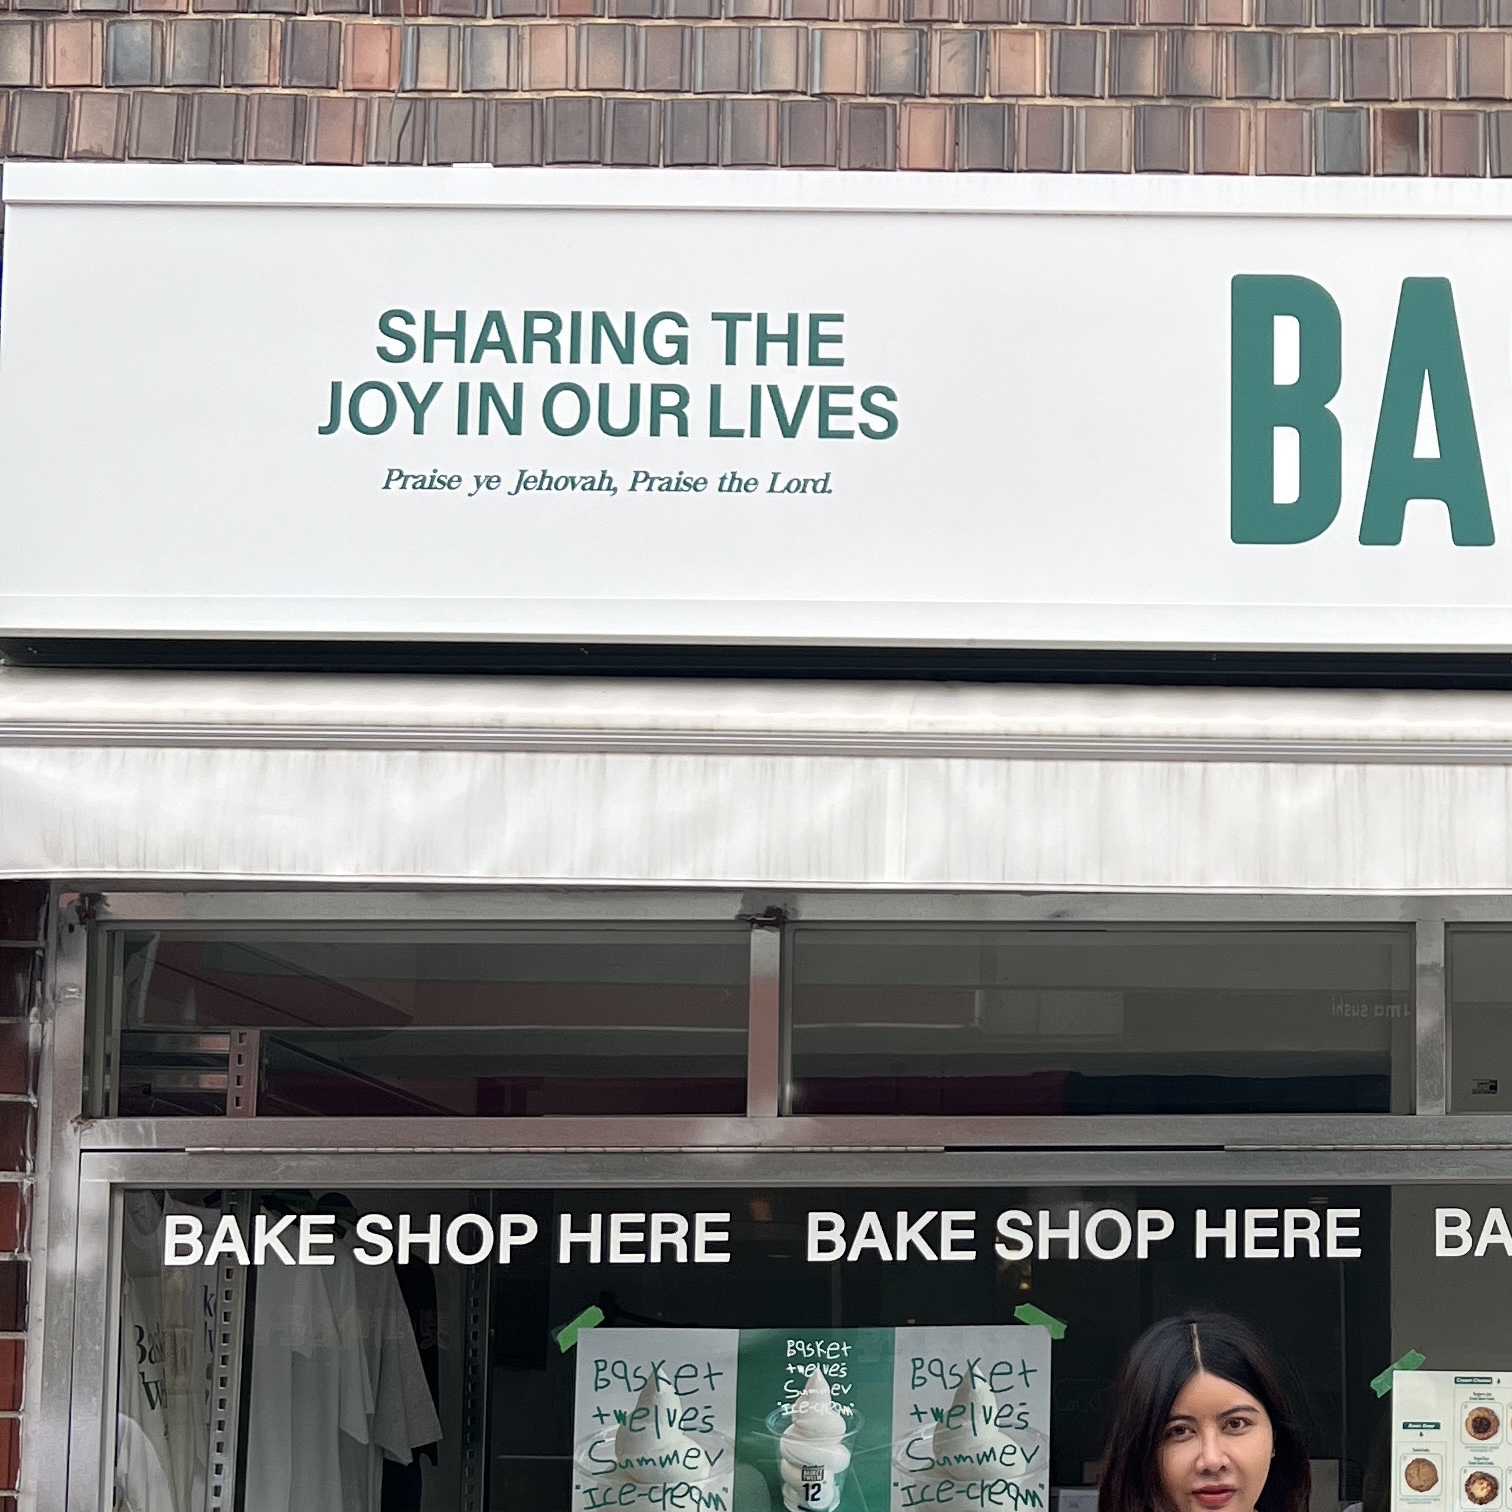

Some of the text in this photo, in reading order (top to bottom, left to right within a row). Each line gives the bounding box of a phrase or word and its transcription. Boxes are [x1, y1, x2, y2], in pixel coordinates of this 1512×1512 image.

[376, 309, 845, 366] SHARING THE
[318, 381, 899, 440] JOY IN OUR LIVES
[382, 469, 834, 497] Praise ye Jehovah, Praise the Lord.
[164, 1215, 335, 1265] BAKE
[354, 1214, 537, 1265] SHOP
[560, 1213, 730, 1263] HERE
[807, 1211, 976, 1261] BAKE
[995, 1210, 1174, 1260] SHOP
[1196, 1209, 1361, 1258] HERE
[786, 1339, 852, 1360] Basket
[594, 1359, 723, 1396] Basket
[911, 1357, 1037, 1393] Basket
[802, 1483, 822, 1501] 12
